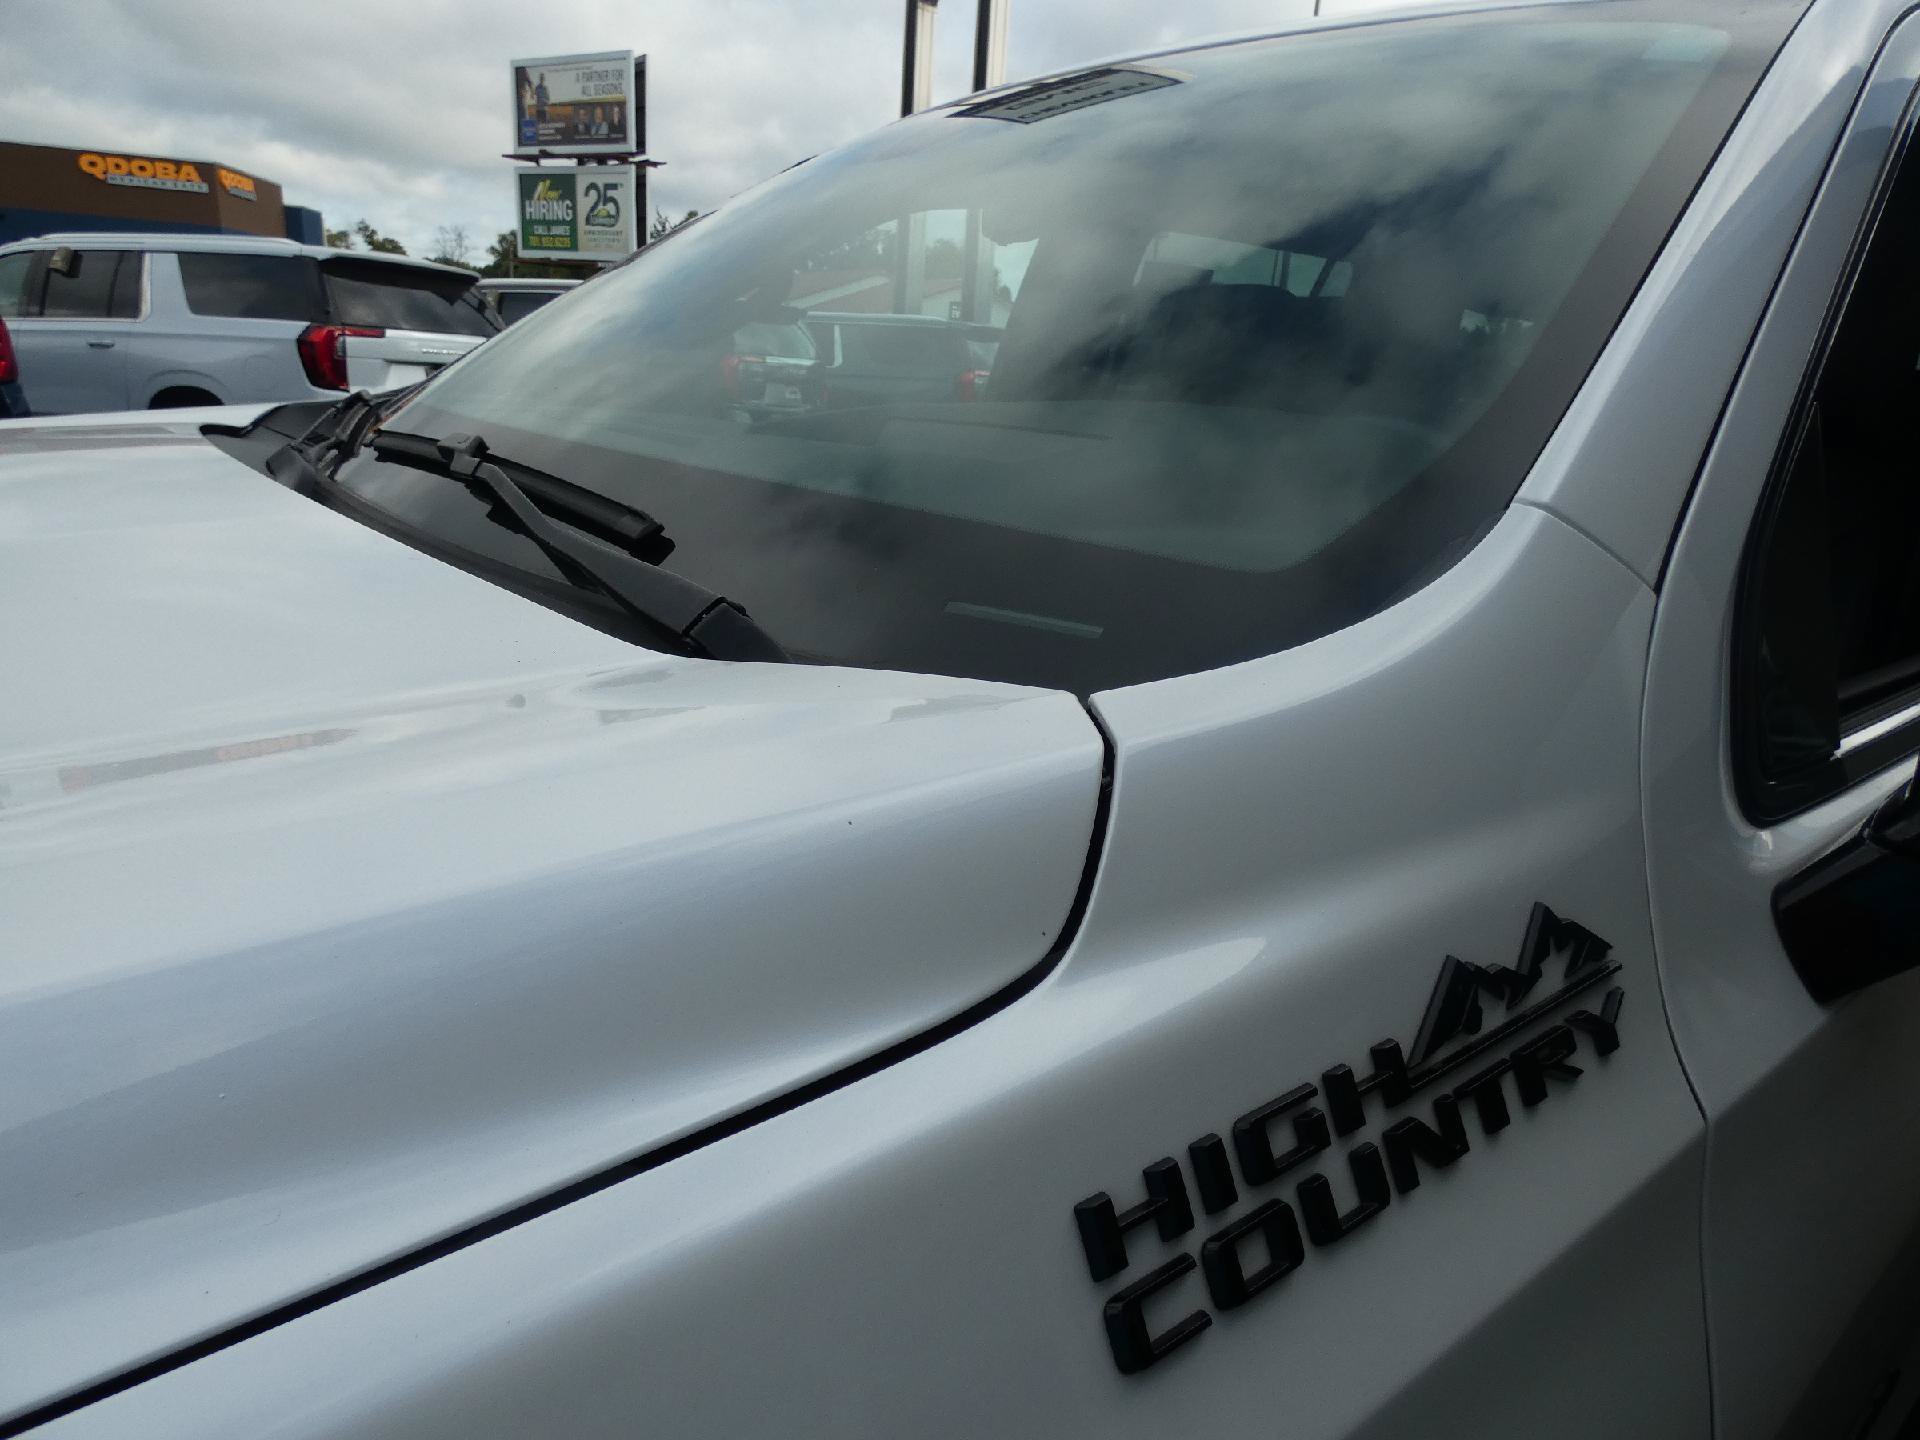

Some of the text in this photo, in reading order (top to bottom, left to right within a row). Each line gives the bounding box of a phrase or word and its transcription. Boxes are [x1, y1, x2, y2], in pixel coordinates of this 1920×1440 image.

[79, 153, 201, 182] QDOBA
[525, 200, 573, 221] HIRING
[1074, 1038, 1411, 1283] HIGH
[1104, 987, 1625, 1375] COUNTRY
